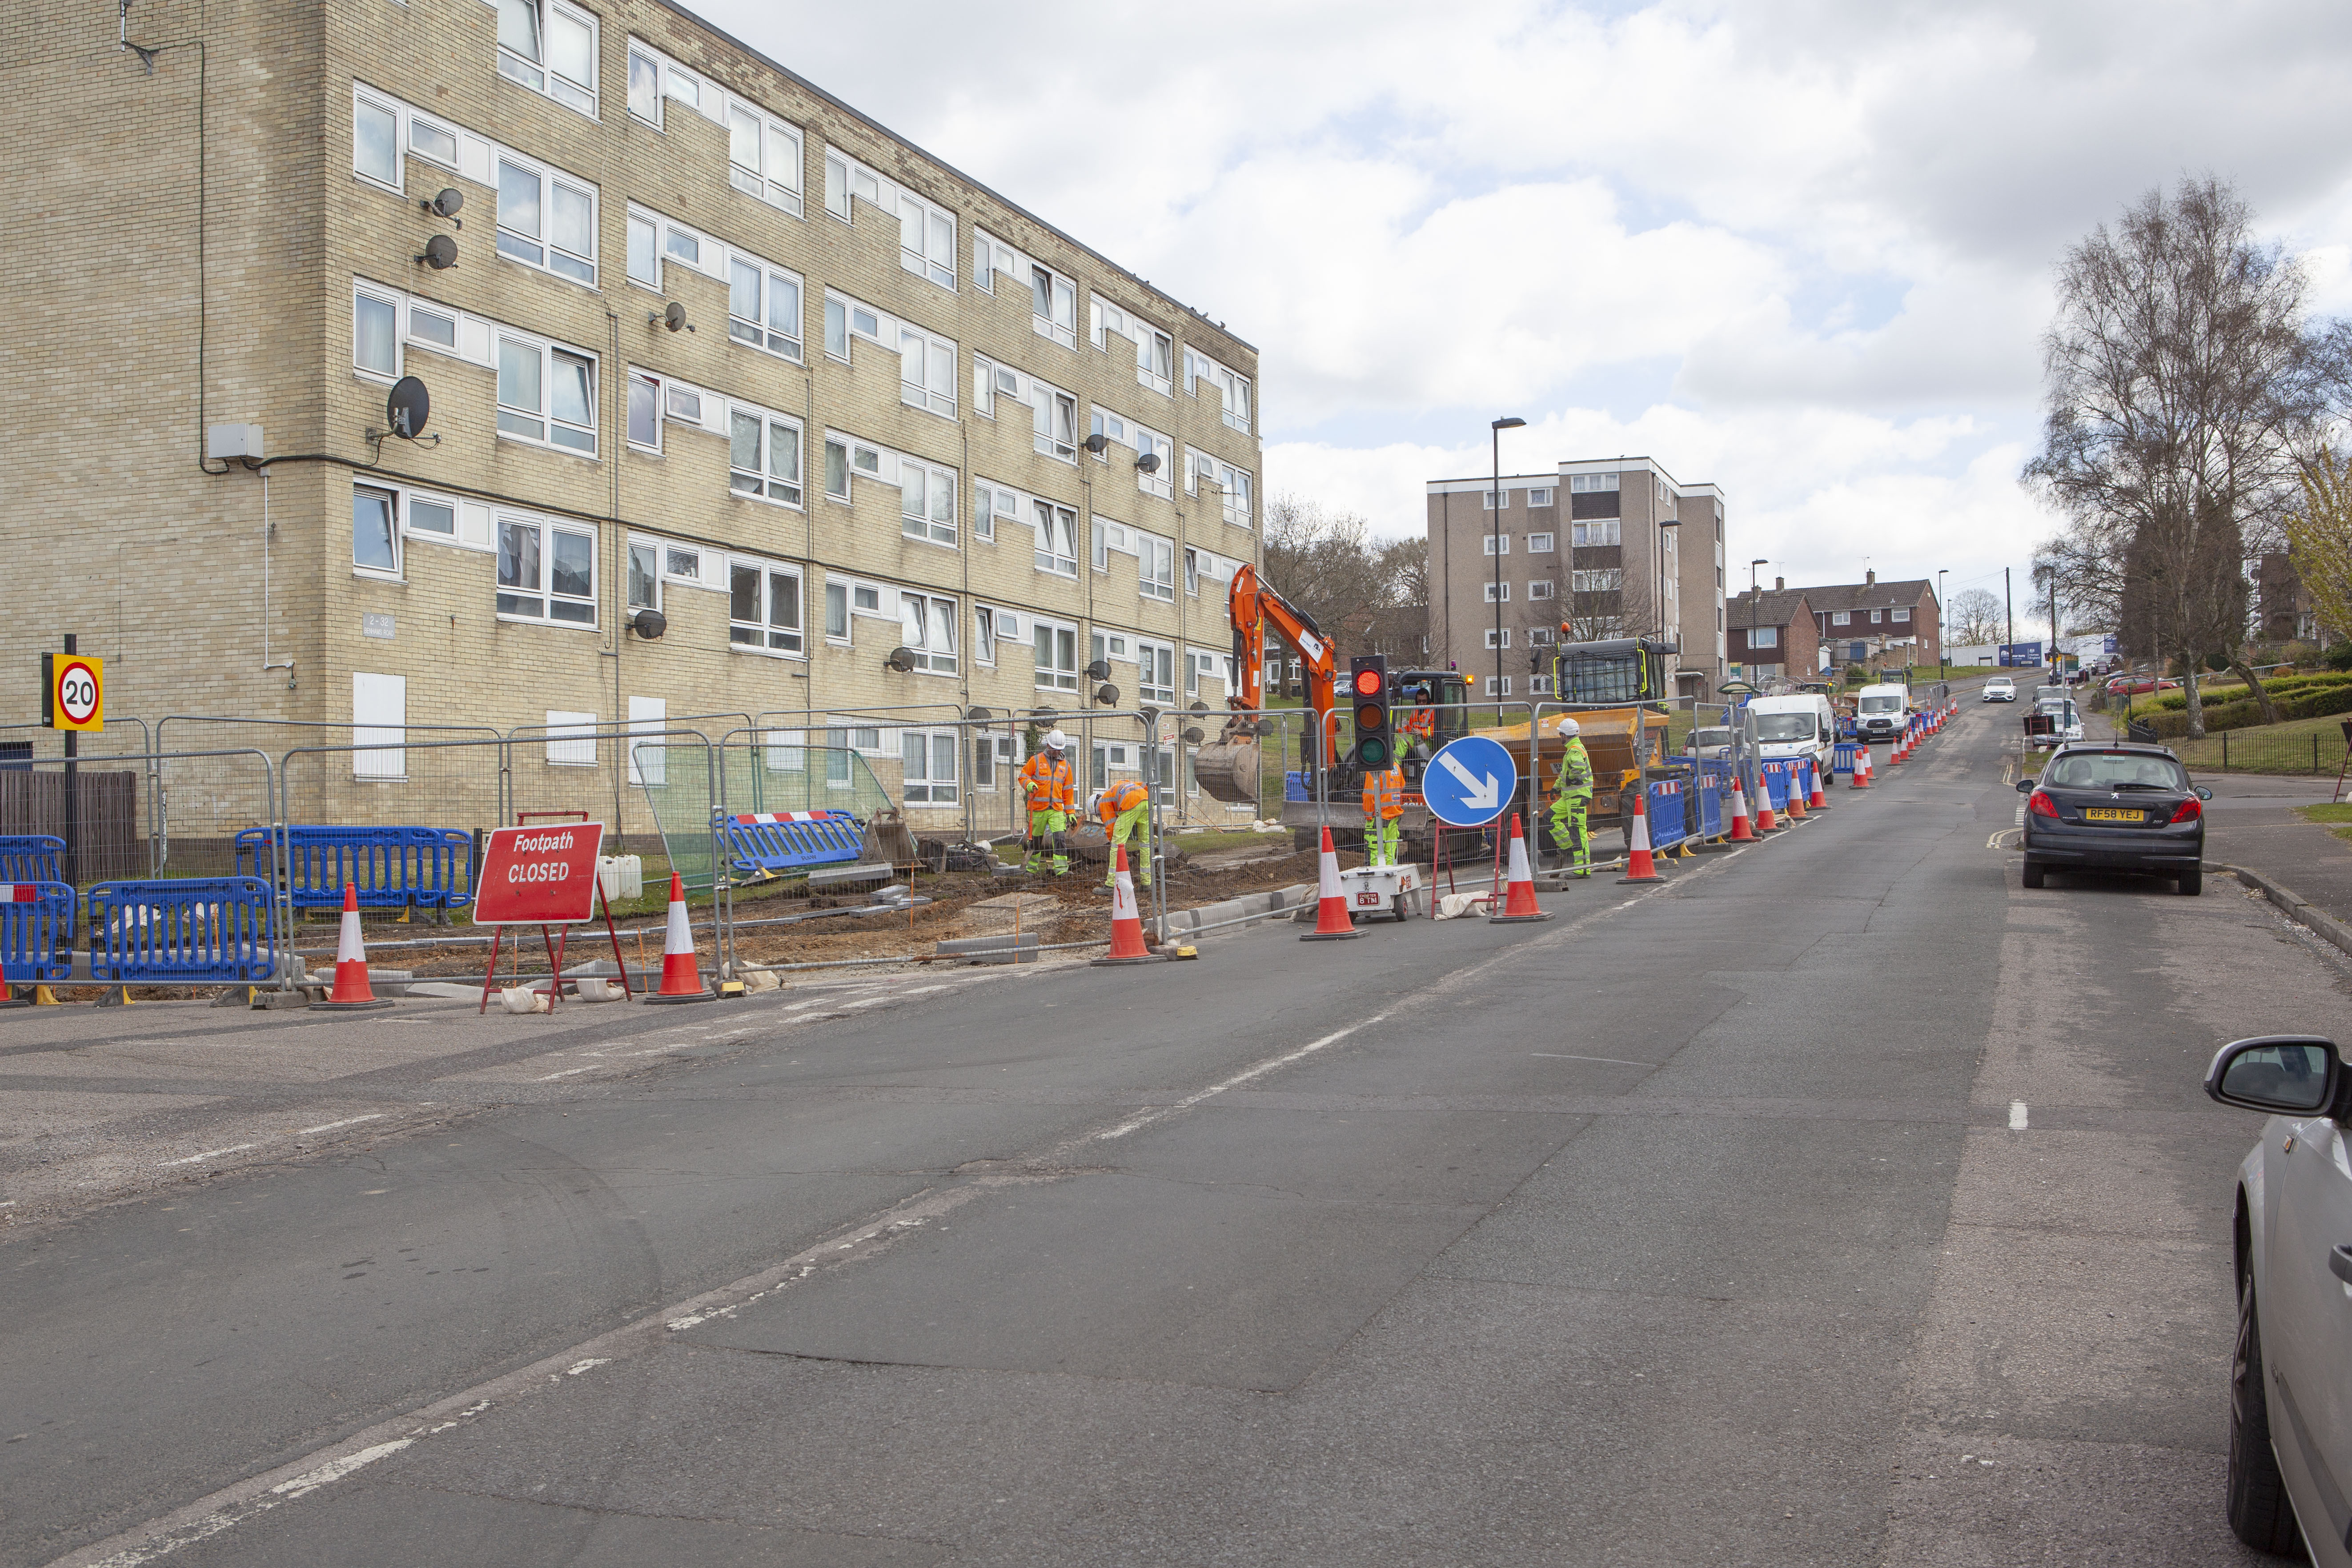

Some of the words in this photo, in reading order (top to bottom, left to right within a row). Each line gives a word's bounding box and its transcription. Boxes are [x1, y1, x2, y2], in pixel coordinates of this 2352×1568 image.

[364, 627, 382, 636] BENHAMS
[66, 680, 93, 706] 20
[2091, 809, 2116, 818] RF58
[2120, 810, 2139, 819] YEJ
[514, 831, 574, 854] Footpath
[508, 862, 569, 883] CLOSED
